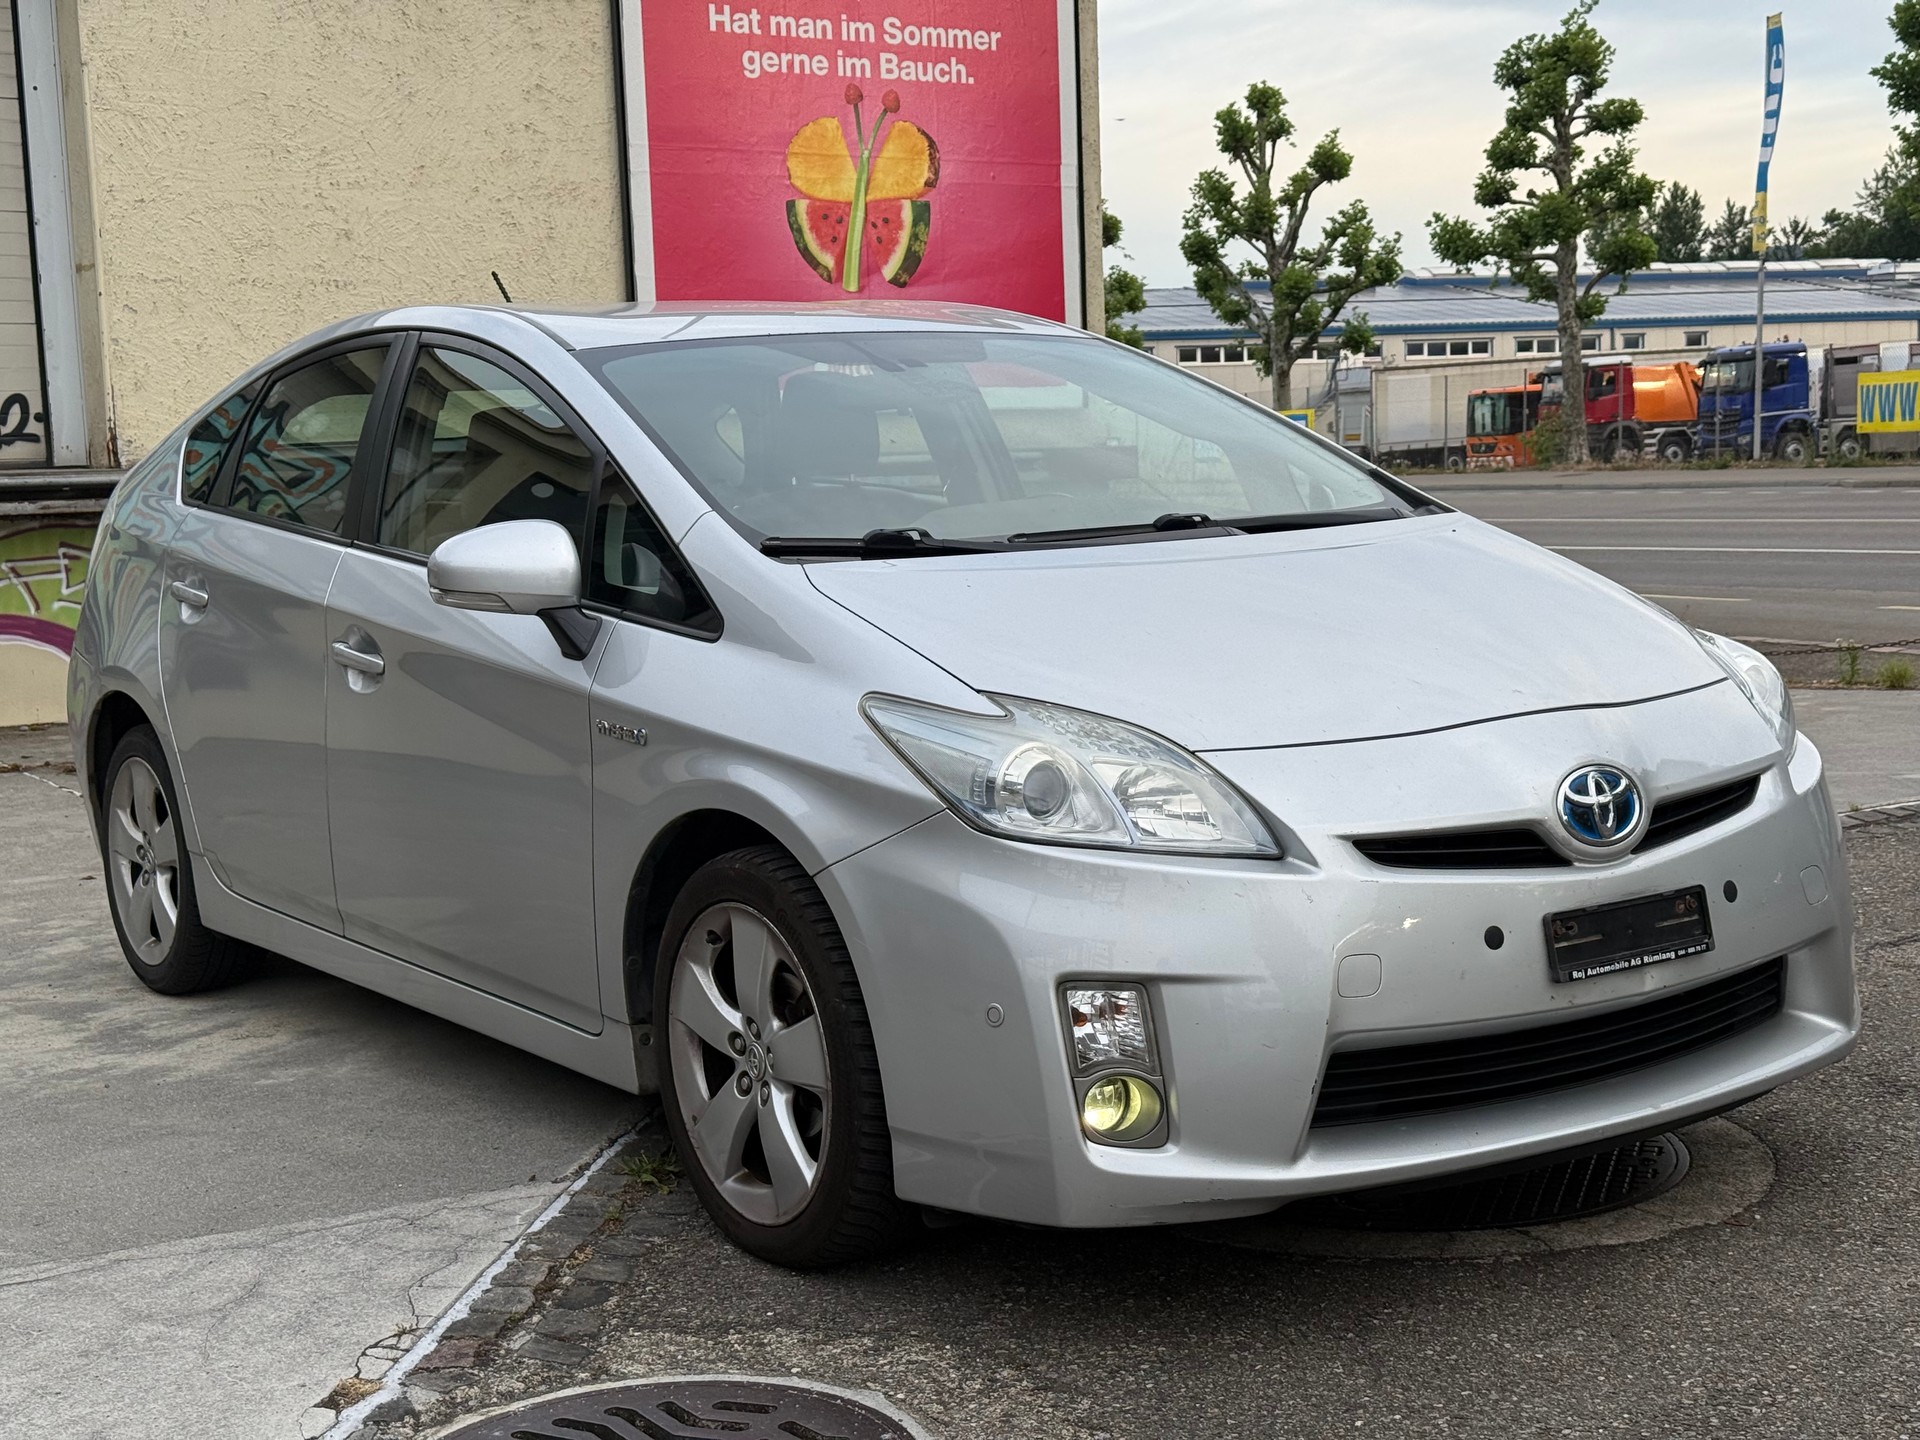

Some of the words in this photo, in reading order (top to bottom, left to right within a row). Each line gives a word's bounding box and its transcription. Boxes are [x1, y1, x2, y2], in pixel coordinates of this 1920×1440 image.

[708, 3, 762, 35] Hat
[769, 14, 833, 40] man
[840, 13, 875, 43] im
[882, 16, 1001, 51] Sommer
[742, 49, 829, 78] gerne
[837, 49, 872, 78] im
[879, 52, 975, 84] Bauch.
[1572, 970, 1586, 979] Roj
[1587, 961, 1629, 975] Automobile
[1630, 958, 1642, 967] AG
